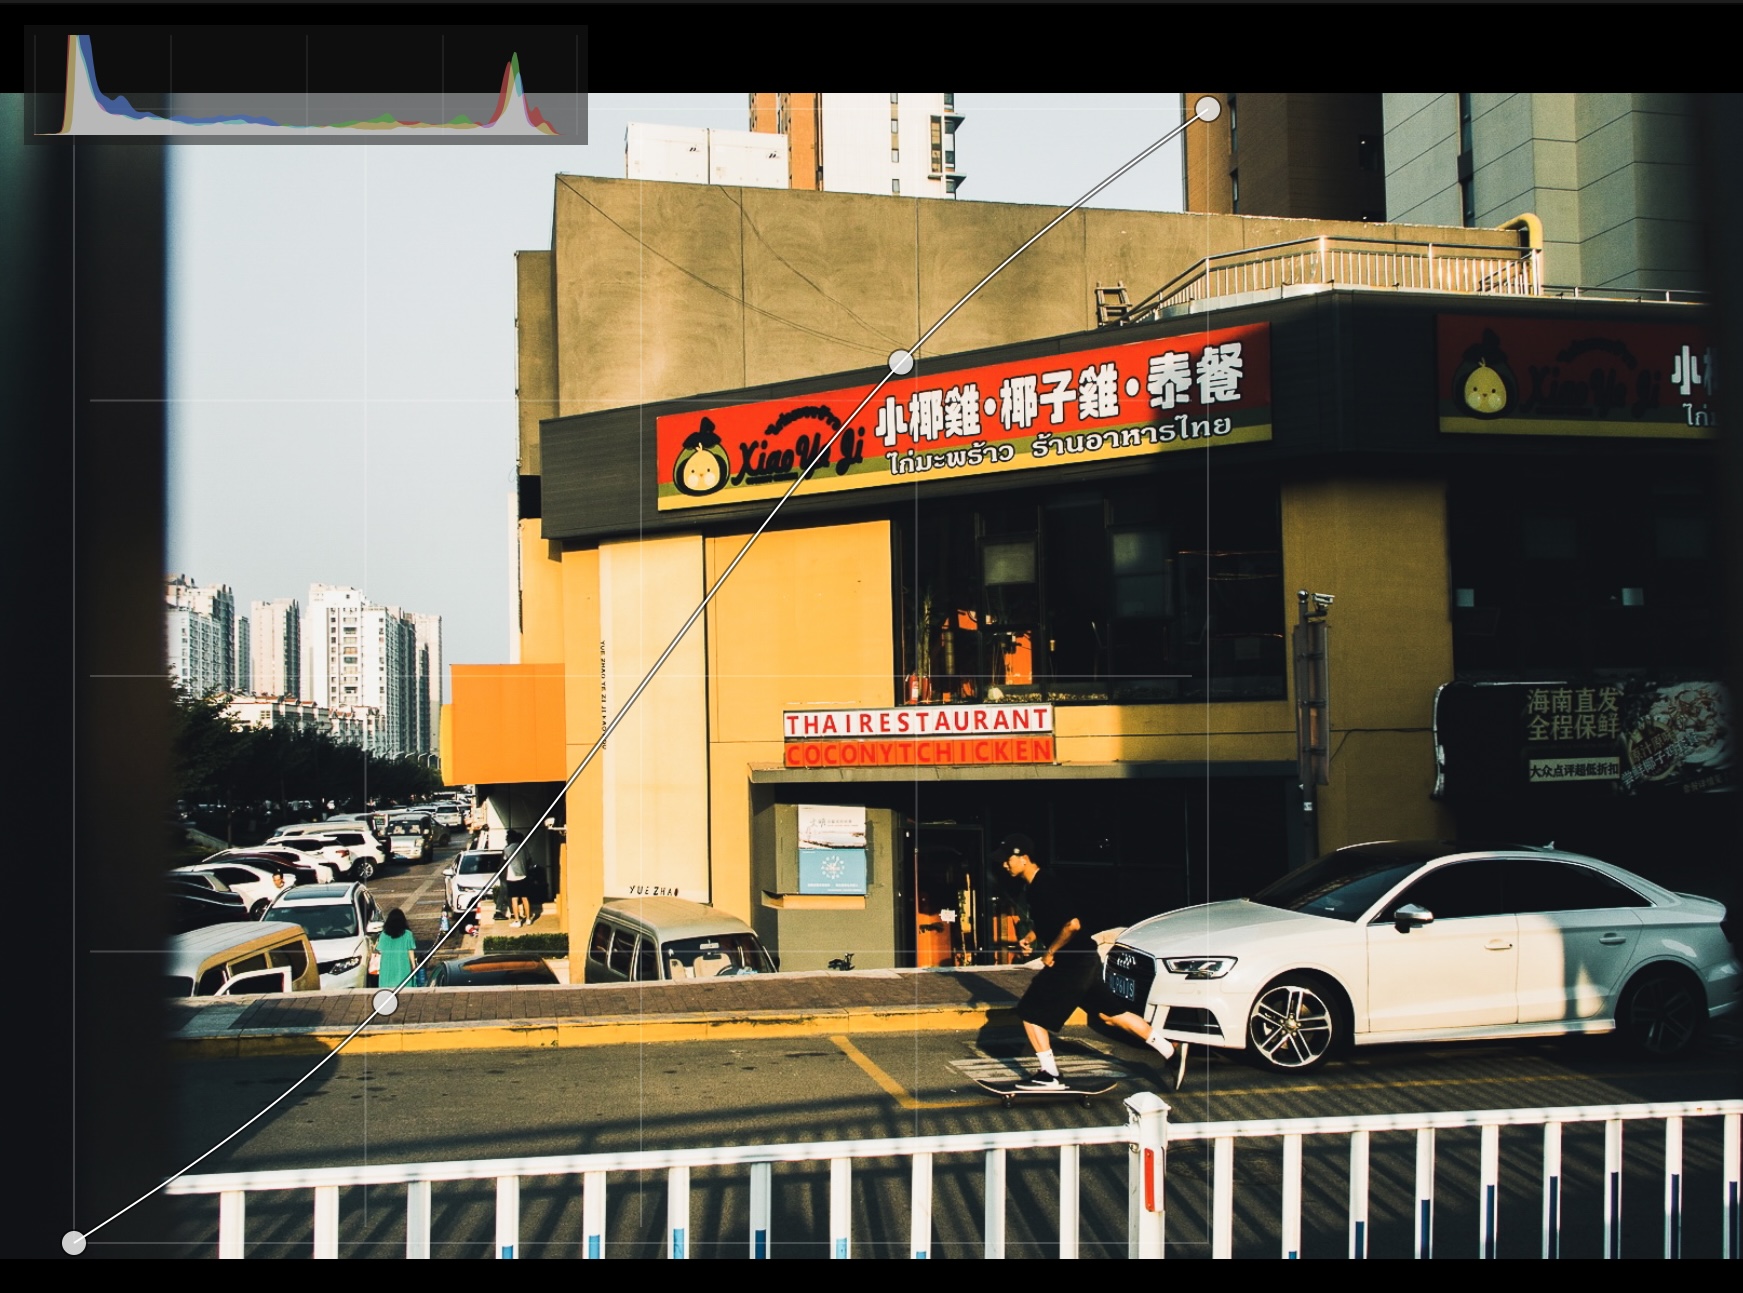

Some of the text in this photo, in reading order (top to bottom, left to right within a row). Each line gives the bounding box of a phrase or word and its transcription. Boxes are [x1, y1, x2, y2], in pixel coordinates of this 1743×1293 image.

[731, 440, 794, 485] Xiao
[1527, 686, 1620, 715] 海南直发
[1526, 713, 1621, 741] 全程保鲜
[1530, 763, 1619, 779] 大众点评超低折扣
